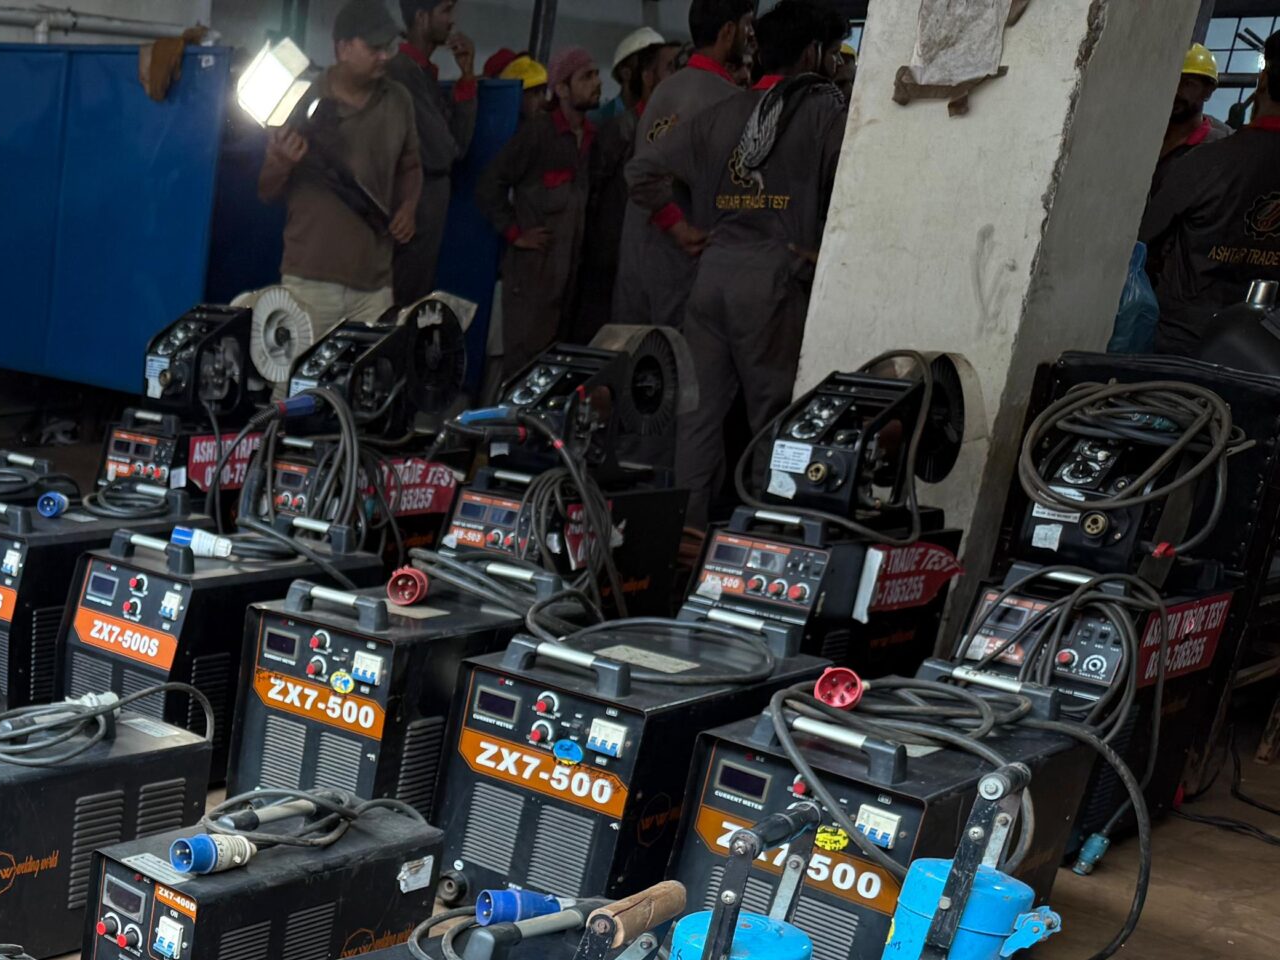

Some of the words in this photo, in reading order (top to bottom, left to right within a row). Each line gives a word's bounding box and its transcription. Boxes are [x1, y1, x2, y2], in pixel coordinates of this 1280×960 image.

[90, 619, 160, 657] ZX7-500S
[267, 676, 375, 729] ZX7-500
[475, 740, 613, 805] ZX7-500
[714, 789, 742, 804] CURRENT
[742, 796, 763, 811] METER
[716, 819, 882, 900] Z7500
